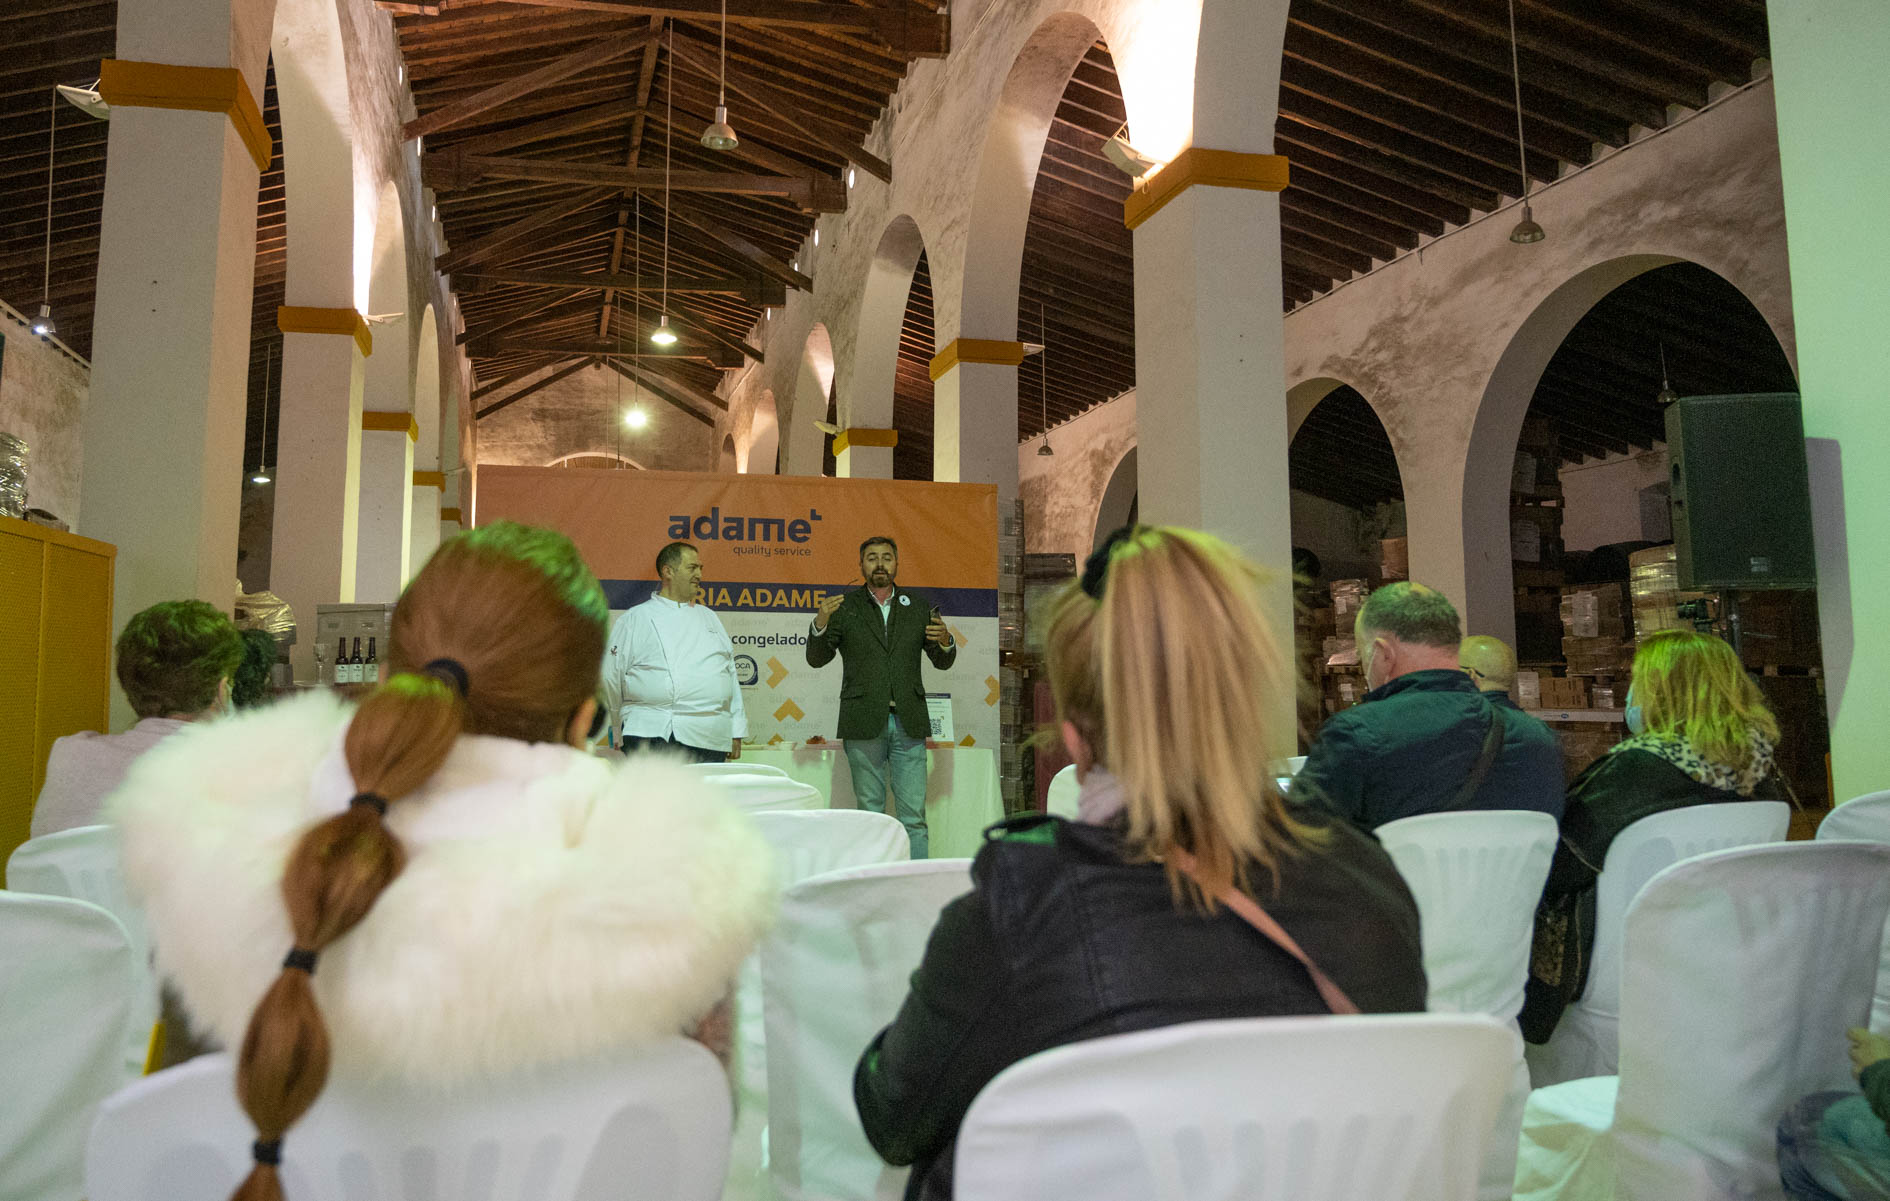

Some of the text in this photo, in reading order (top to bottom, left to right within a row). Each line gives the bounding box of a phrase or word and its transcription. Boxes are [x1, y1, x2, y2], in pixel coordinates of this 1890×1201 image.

[667, 506, 812, 543] adame
[733, 545, 812, 557] quality service
[736, 588, 827, 609] ADAME
[730, 632, 808, 648] congelado
